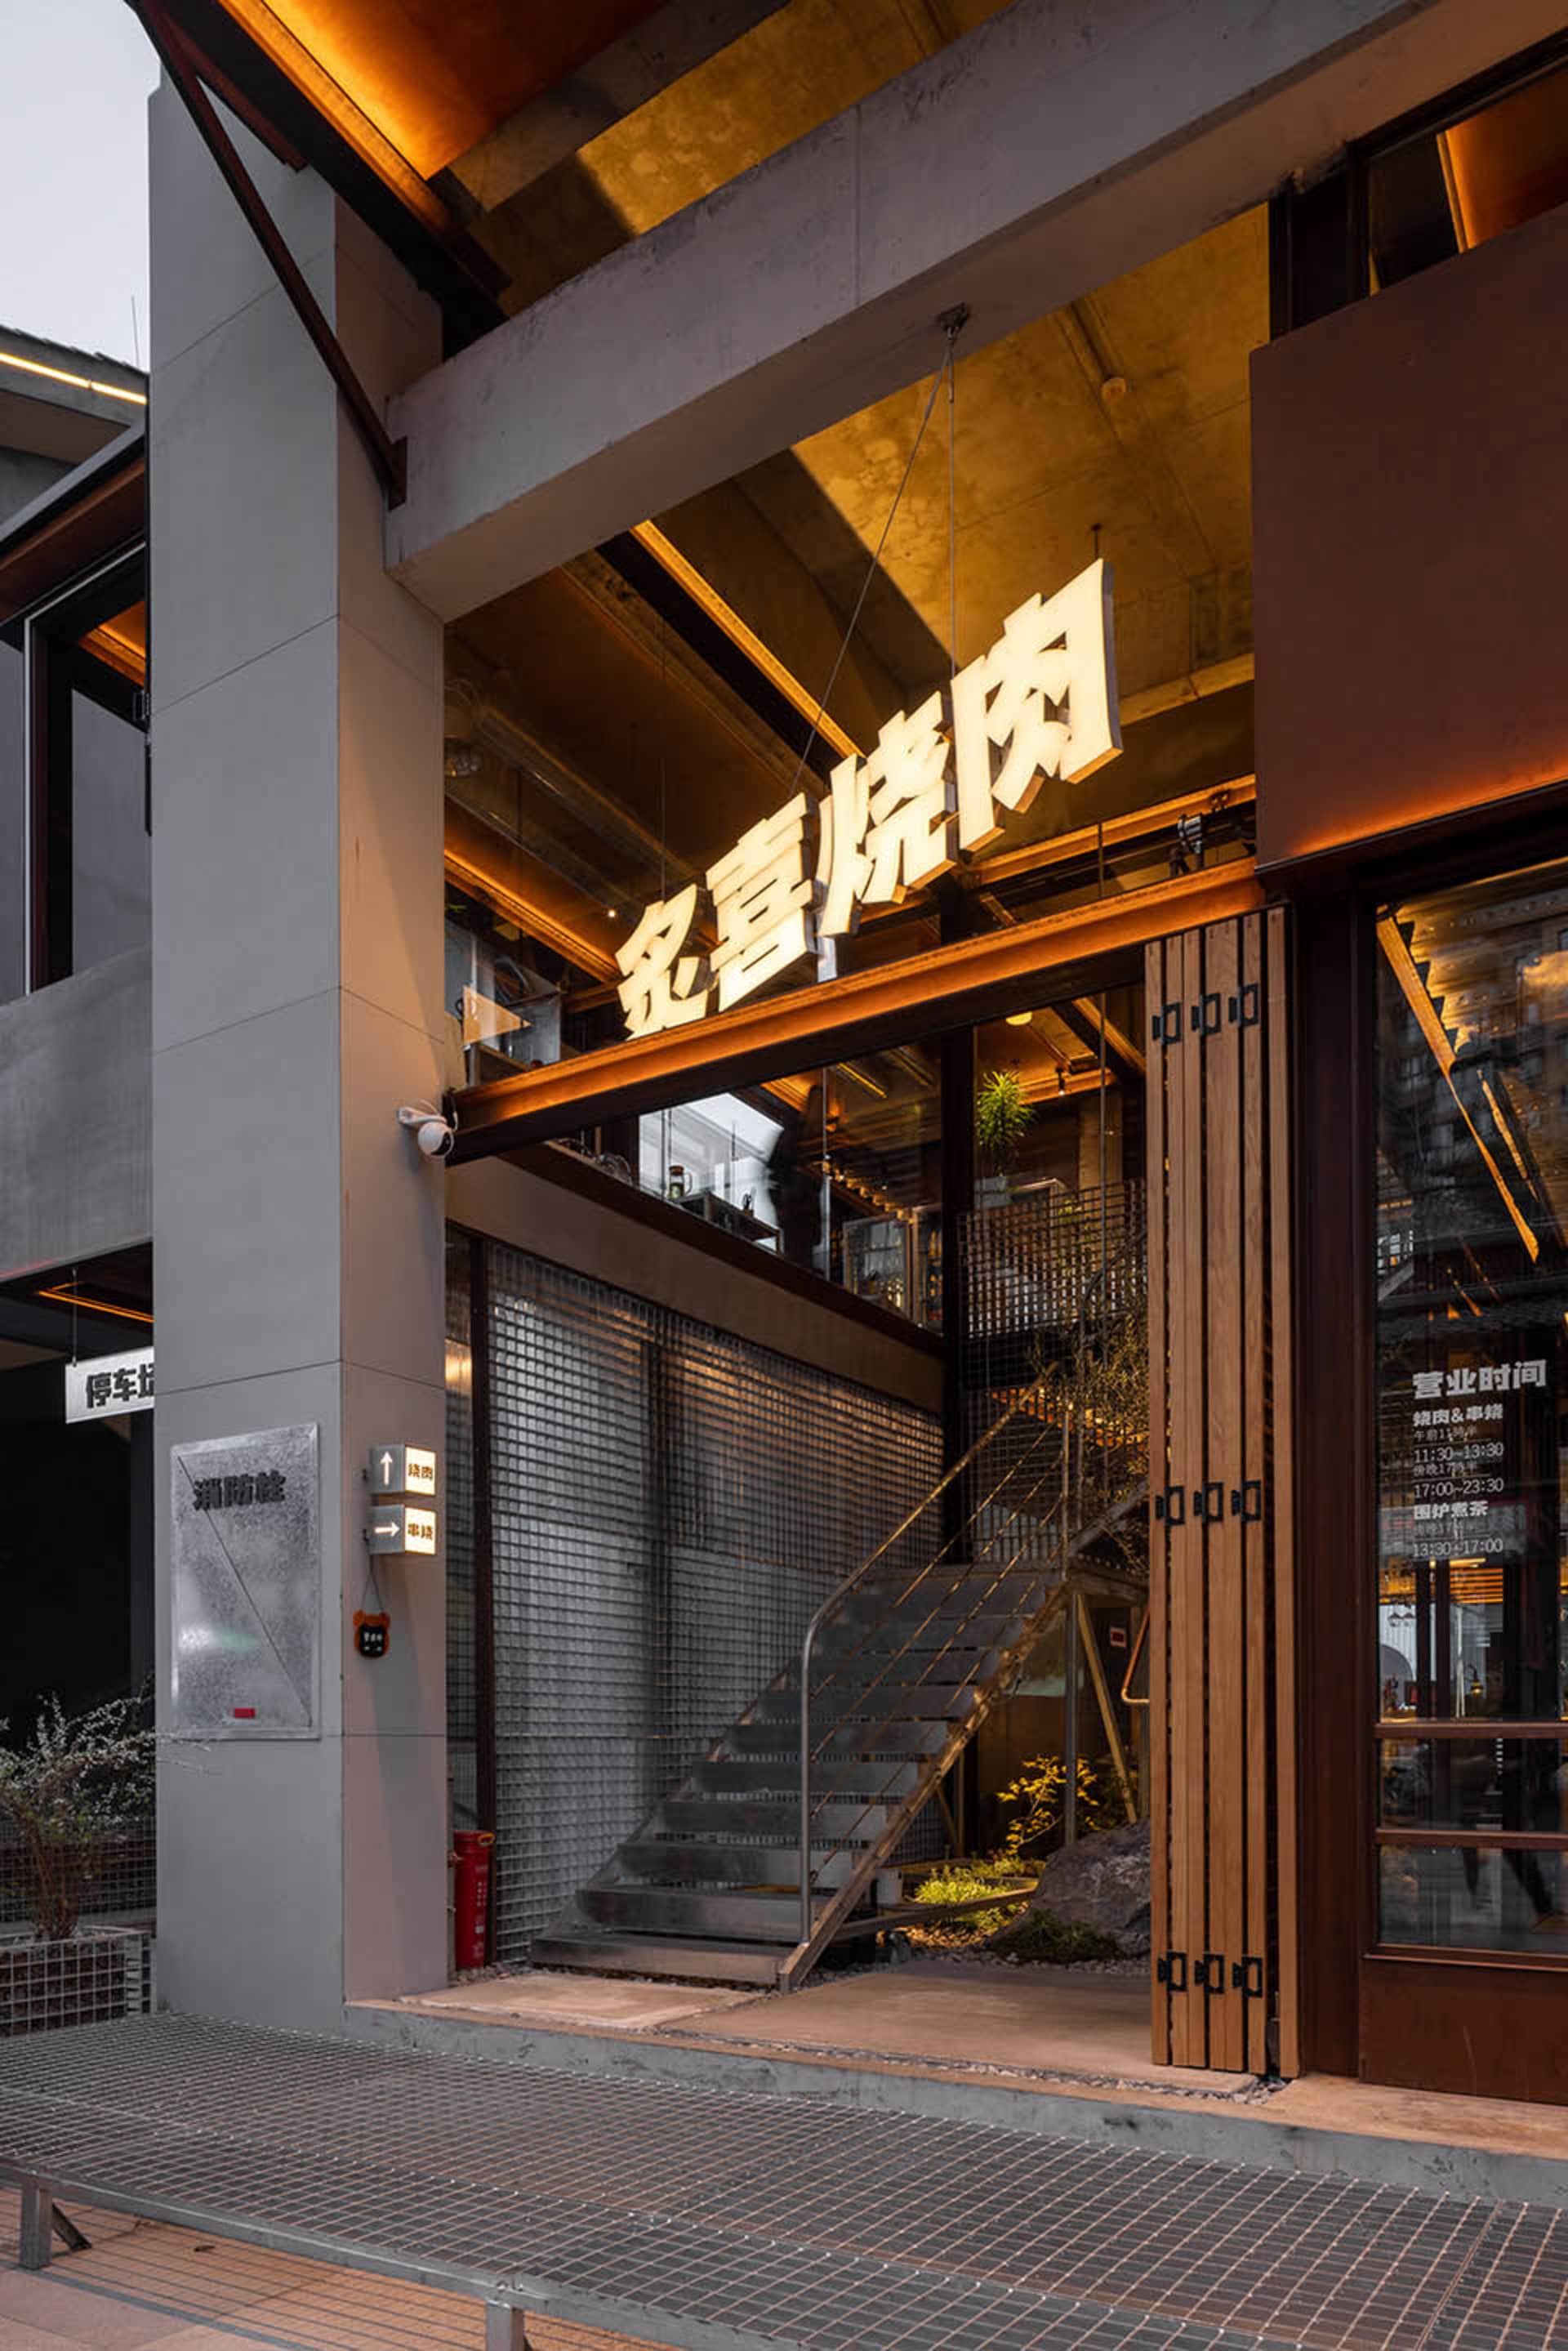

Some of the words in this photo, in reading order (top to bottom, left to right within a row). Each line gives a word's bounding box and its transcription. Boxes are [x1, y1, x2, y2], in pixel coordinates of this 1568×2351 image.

[1412, 1359, 1547, 1399] 营业时间
[193, 1470, 287, 1511] 消防栓
[1414, 1477, 1504, 1499] 17:00~23:30
[1414, 1500, 1489, 1520] 围炉煮茶
